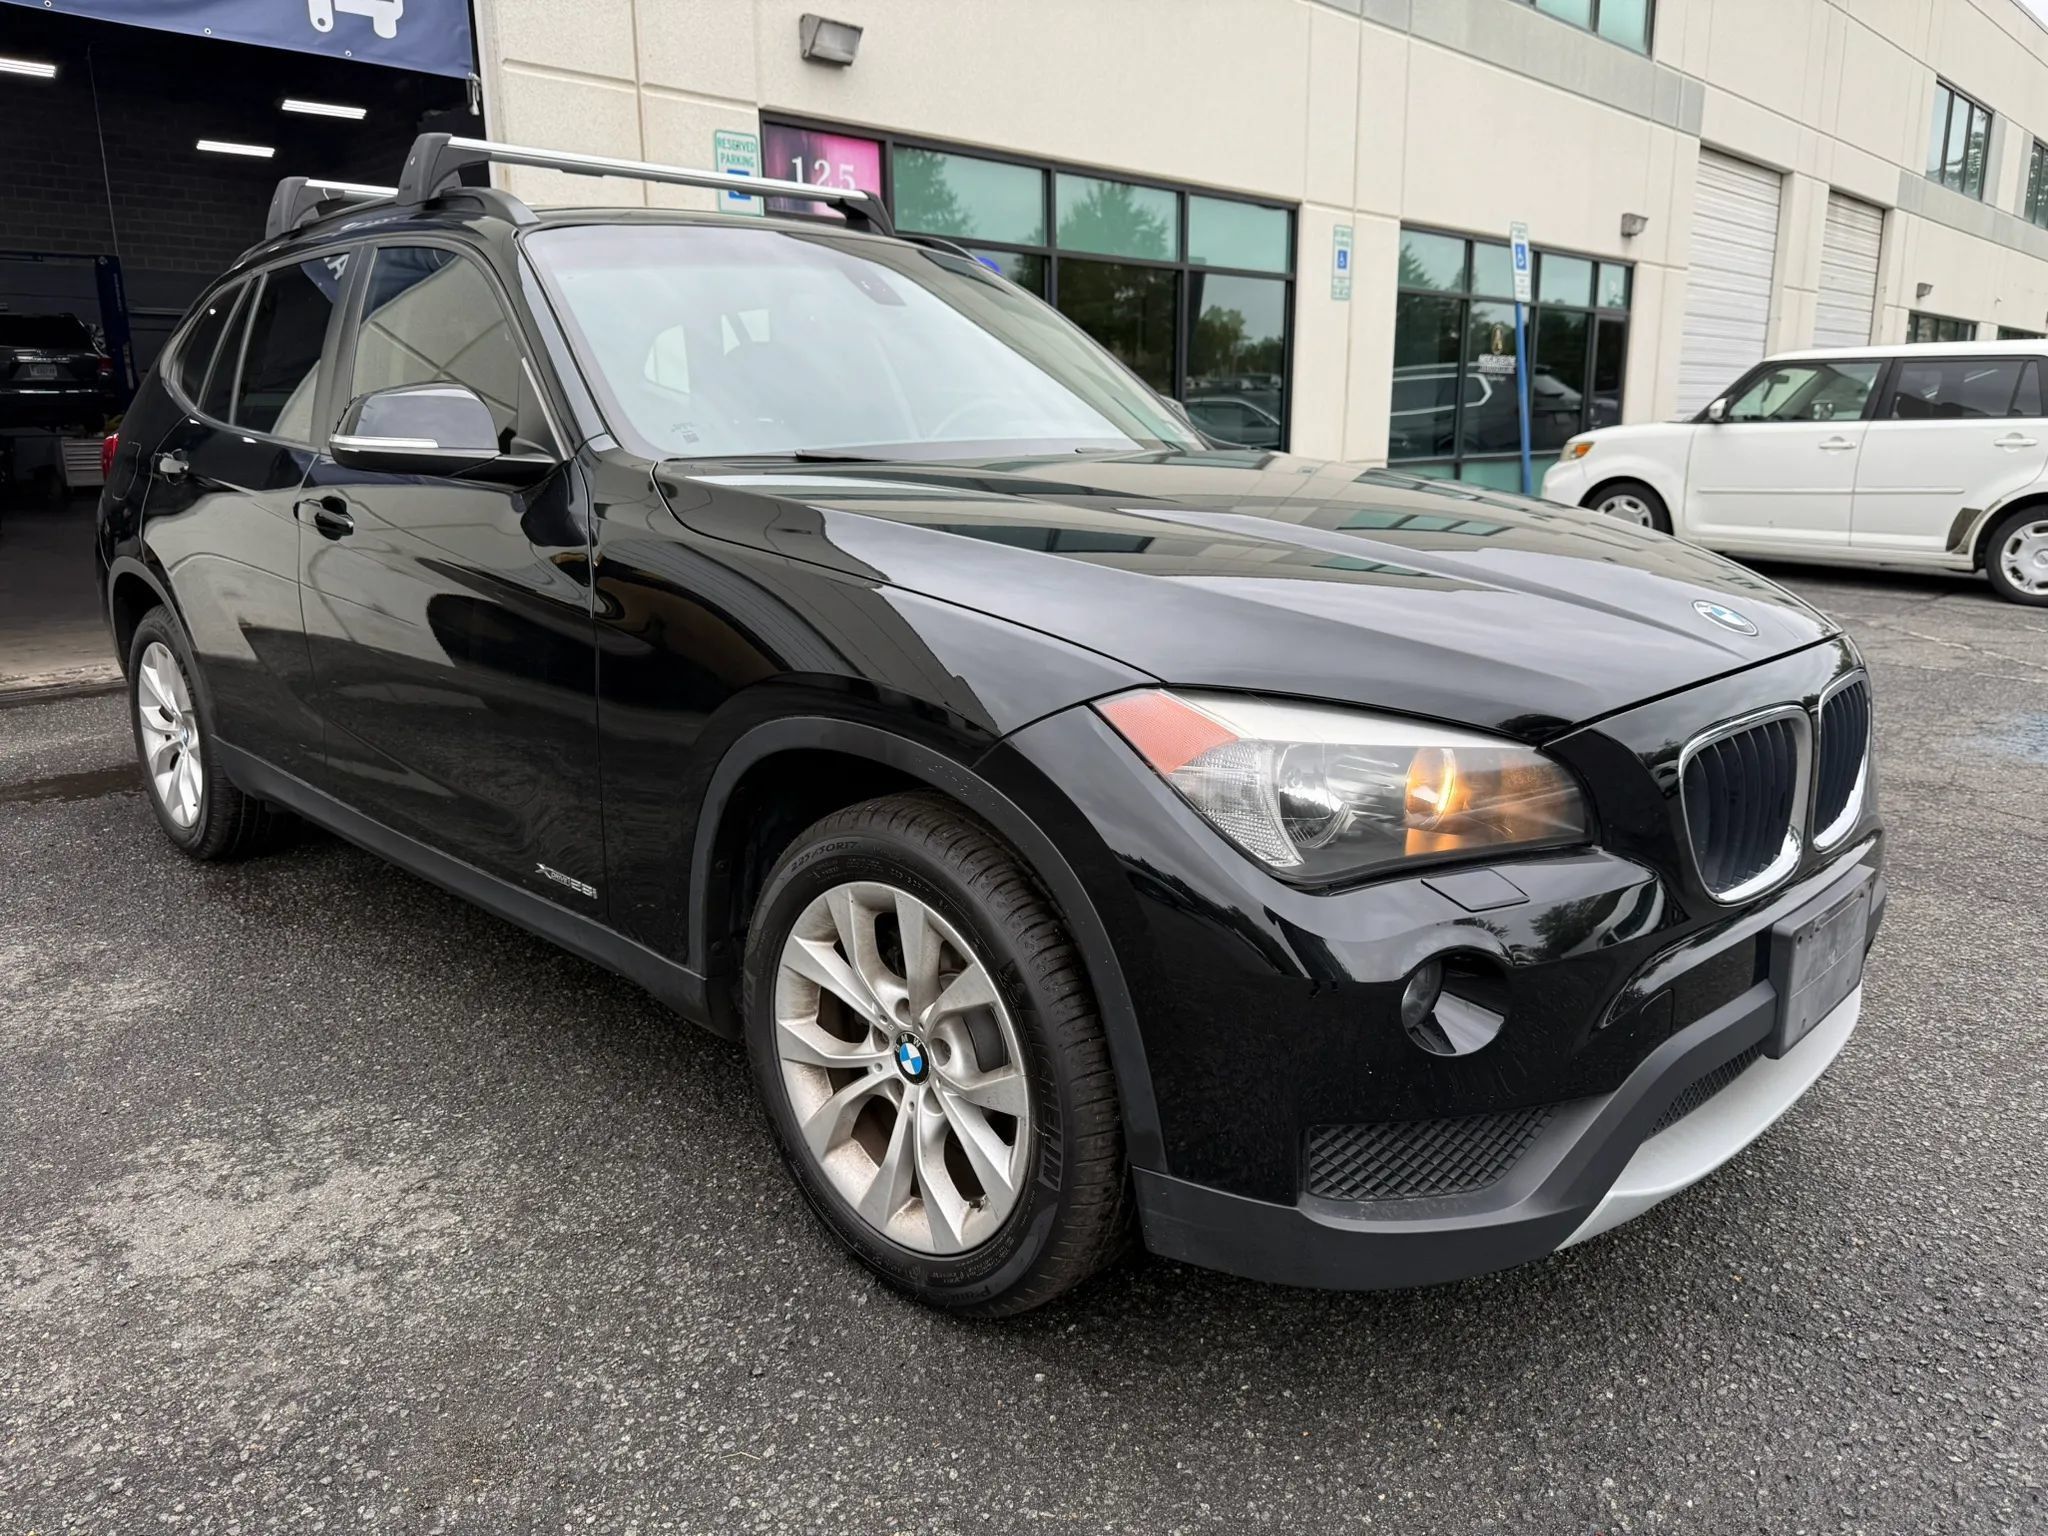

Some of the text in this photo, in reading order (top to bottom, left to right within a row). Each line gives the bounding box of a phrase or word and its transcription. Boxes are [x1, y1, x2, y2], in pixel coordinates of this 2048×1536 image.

[717, 137, 757, 152] RESERVED
[720, 152, 754, 167] PARKING
[791, 156, 855, 190] 125
[895, 1033, 921, 1053] BMW
